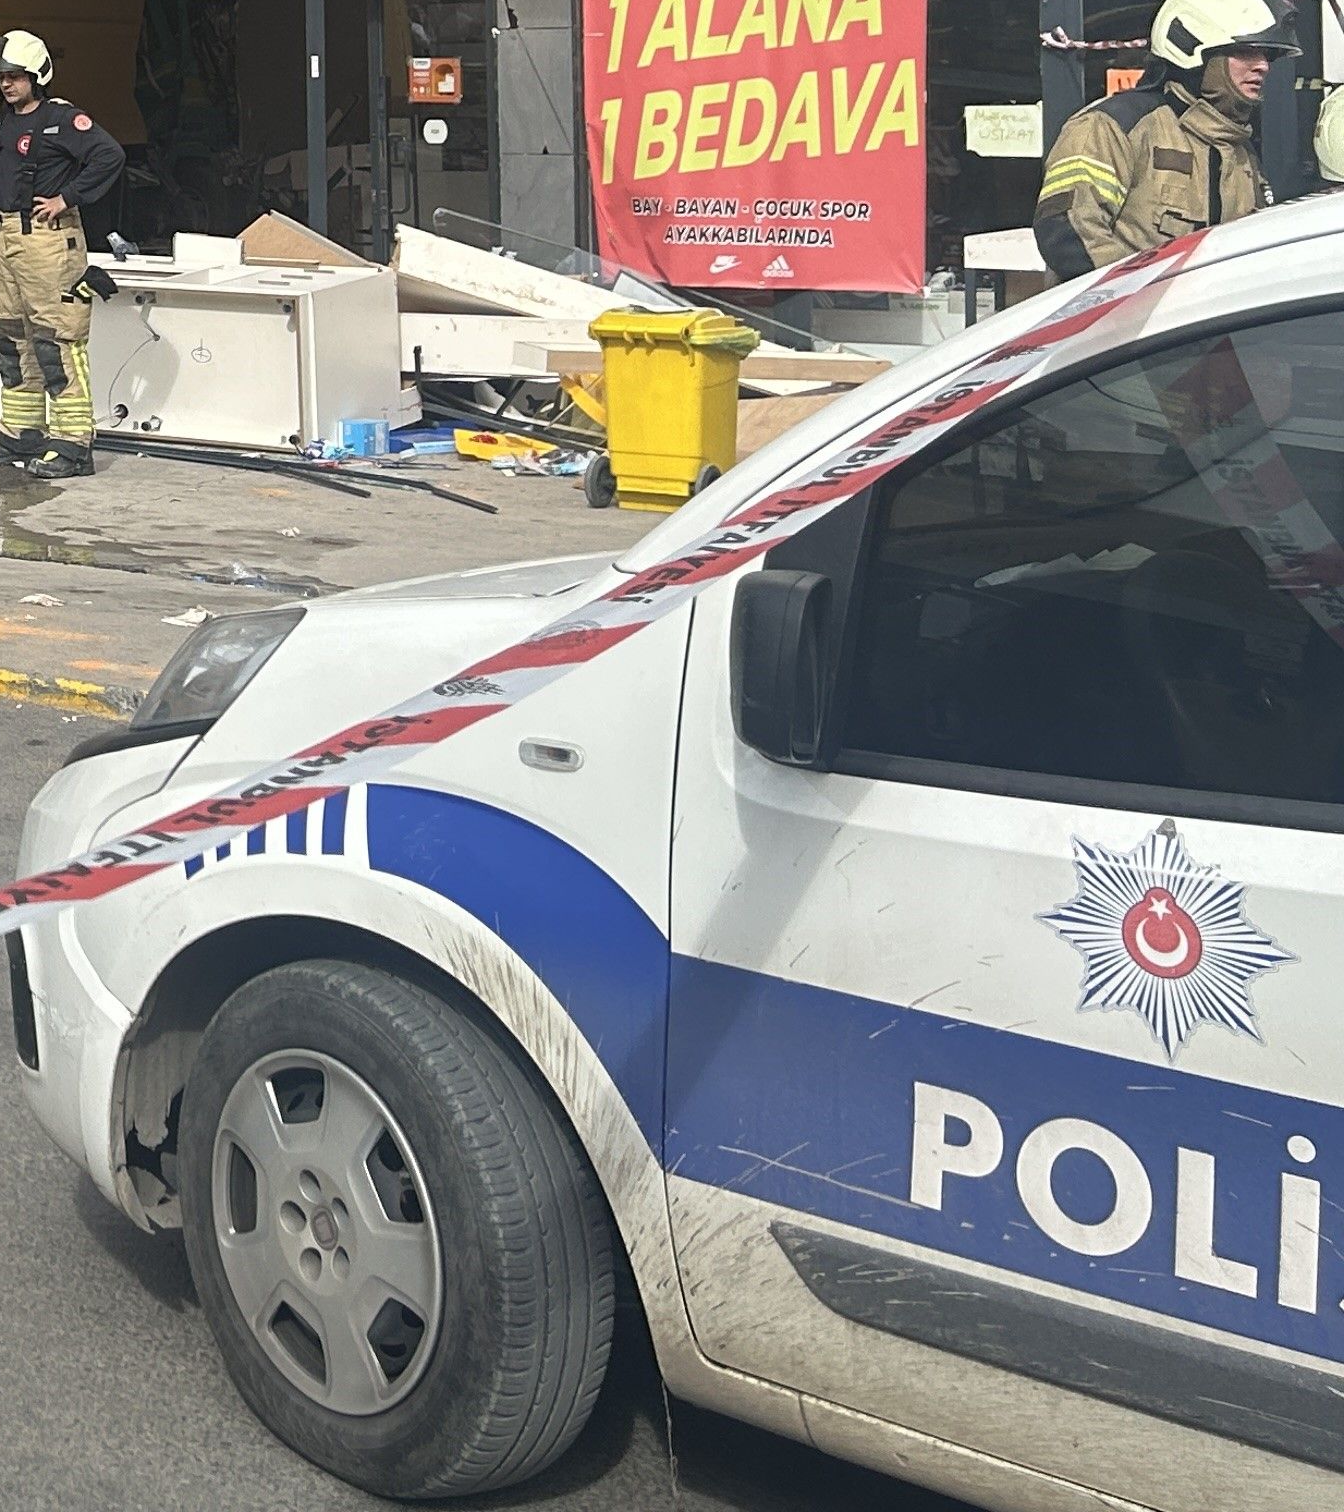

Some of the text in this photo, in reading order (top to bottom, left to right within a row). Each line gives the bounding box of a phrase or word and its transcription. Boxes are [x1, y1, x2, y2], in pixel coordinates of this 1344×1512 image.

[600, 57, 920, 185] 1 BEDAVA
[631, 198, 661, 216] BAY
[674, 198, 738, 217] BAYAN
[753, 198, 814, 224] ÇOCUK
[819, 200, 872, 221] SPOR
[663, 225, 835, 248] AYAKKABILARINDA
[910, 1081, 1344, 1316] POLİ
